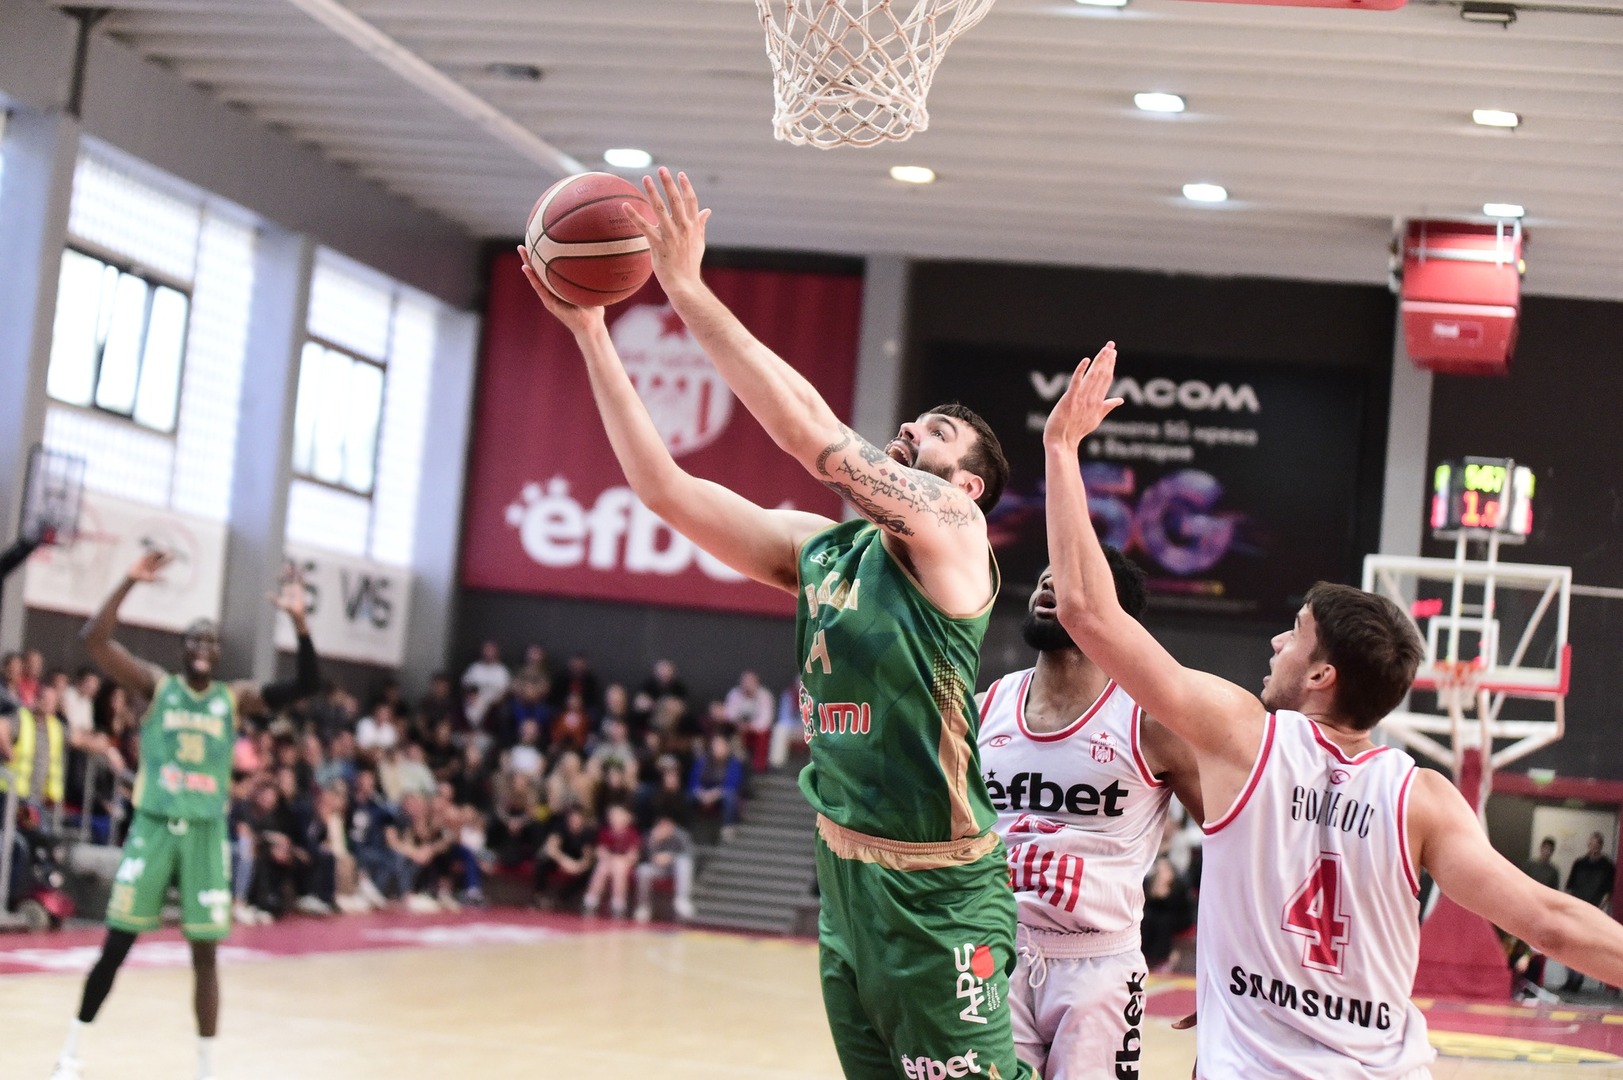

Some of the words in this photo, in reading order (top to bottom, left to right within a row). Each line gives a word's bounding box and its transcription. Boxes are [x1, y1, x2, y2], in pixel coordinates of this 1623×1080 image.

[1029, 371, 1260, 413] VACOM
[513, 480, 796, 582] efb
[1281, 852, 1350, 976] 4
[953, 942, 988, 1024] APS
[1114, 970, 1147, 1080] fbet
[1229, 965, 1391, 1030] SAMSUNG
